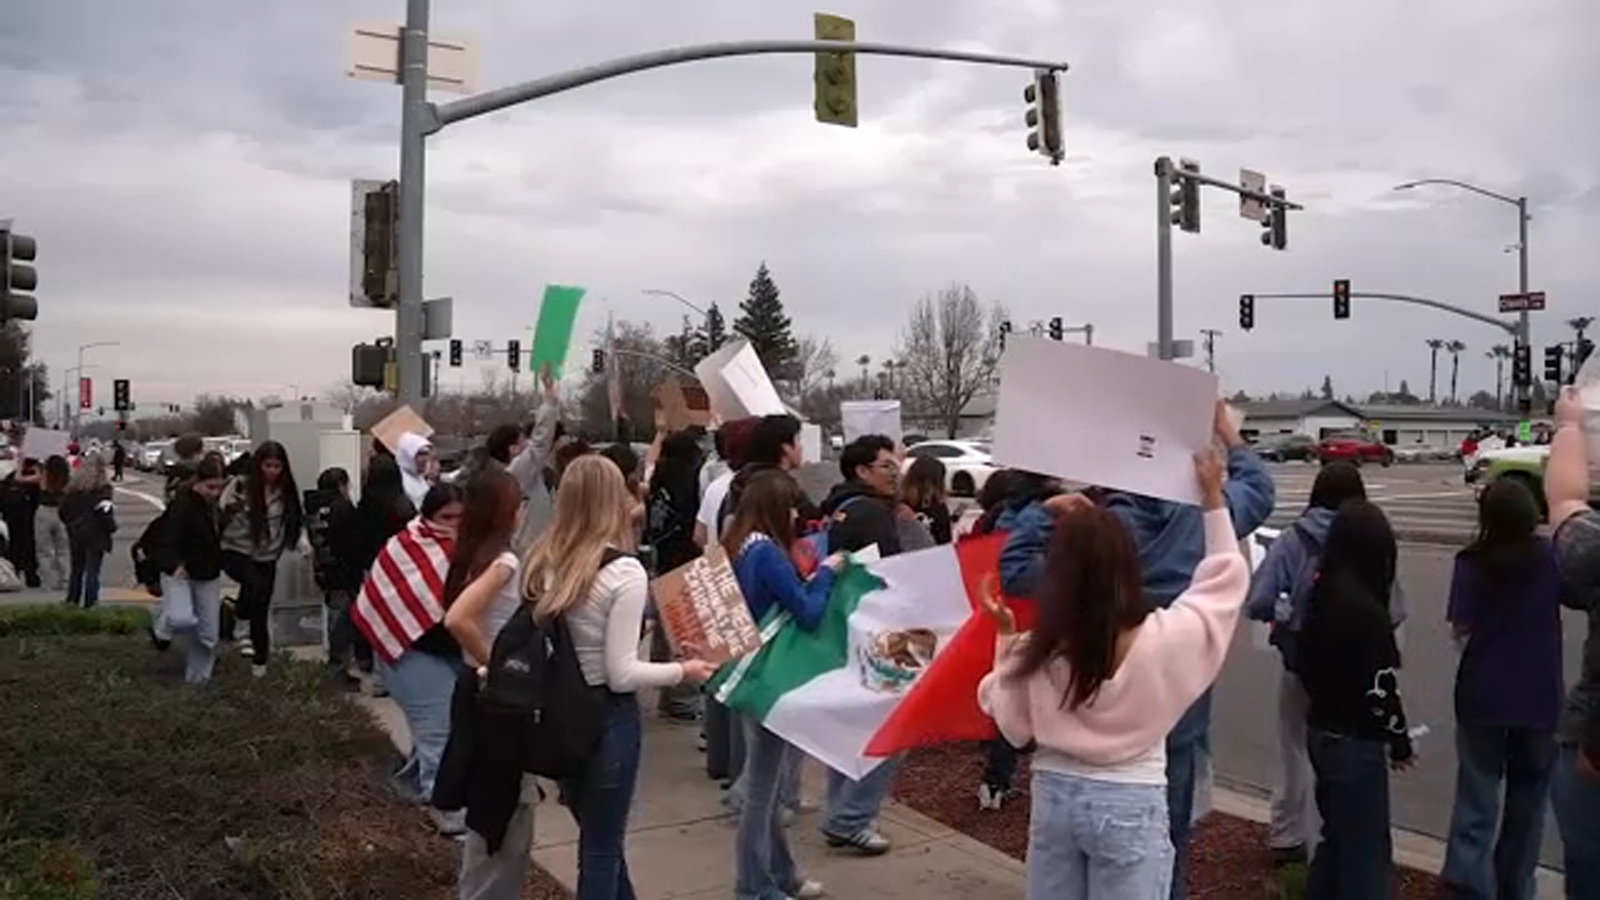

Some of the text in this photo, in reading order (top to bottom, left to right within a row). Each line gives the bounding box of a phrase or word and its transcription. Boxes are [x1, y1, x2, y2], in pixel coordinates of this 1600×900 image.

[710, 559, 757, 645] THE REAL
[702, 617, 724, 649] THE
[723, 626, 744, 657] ARE
